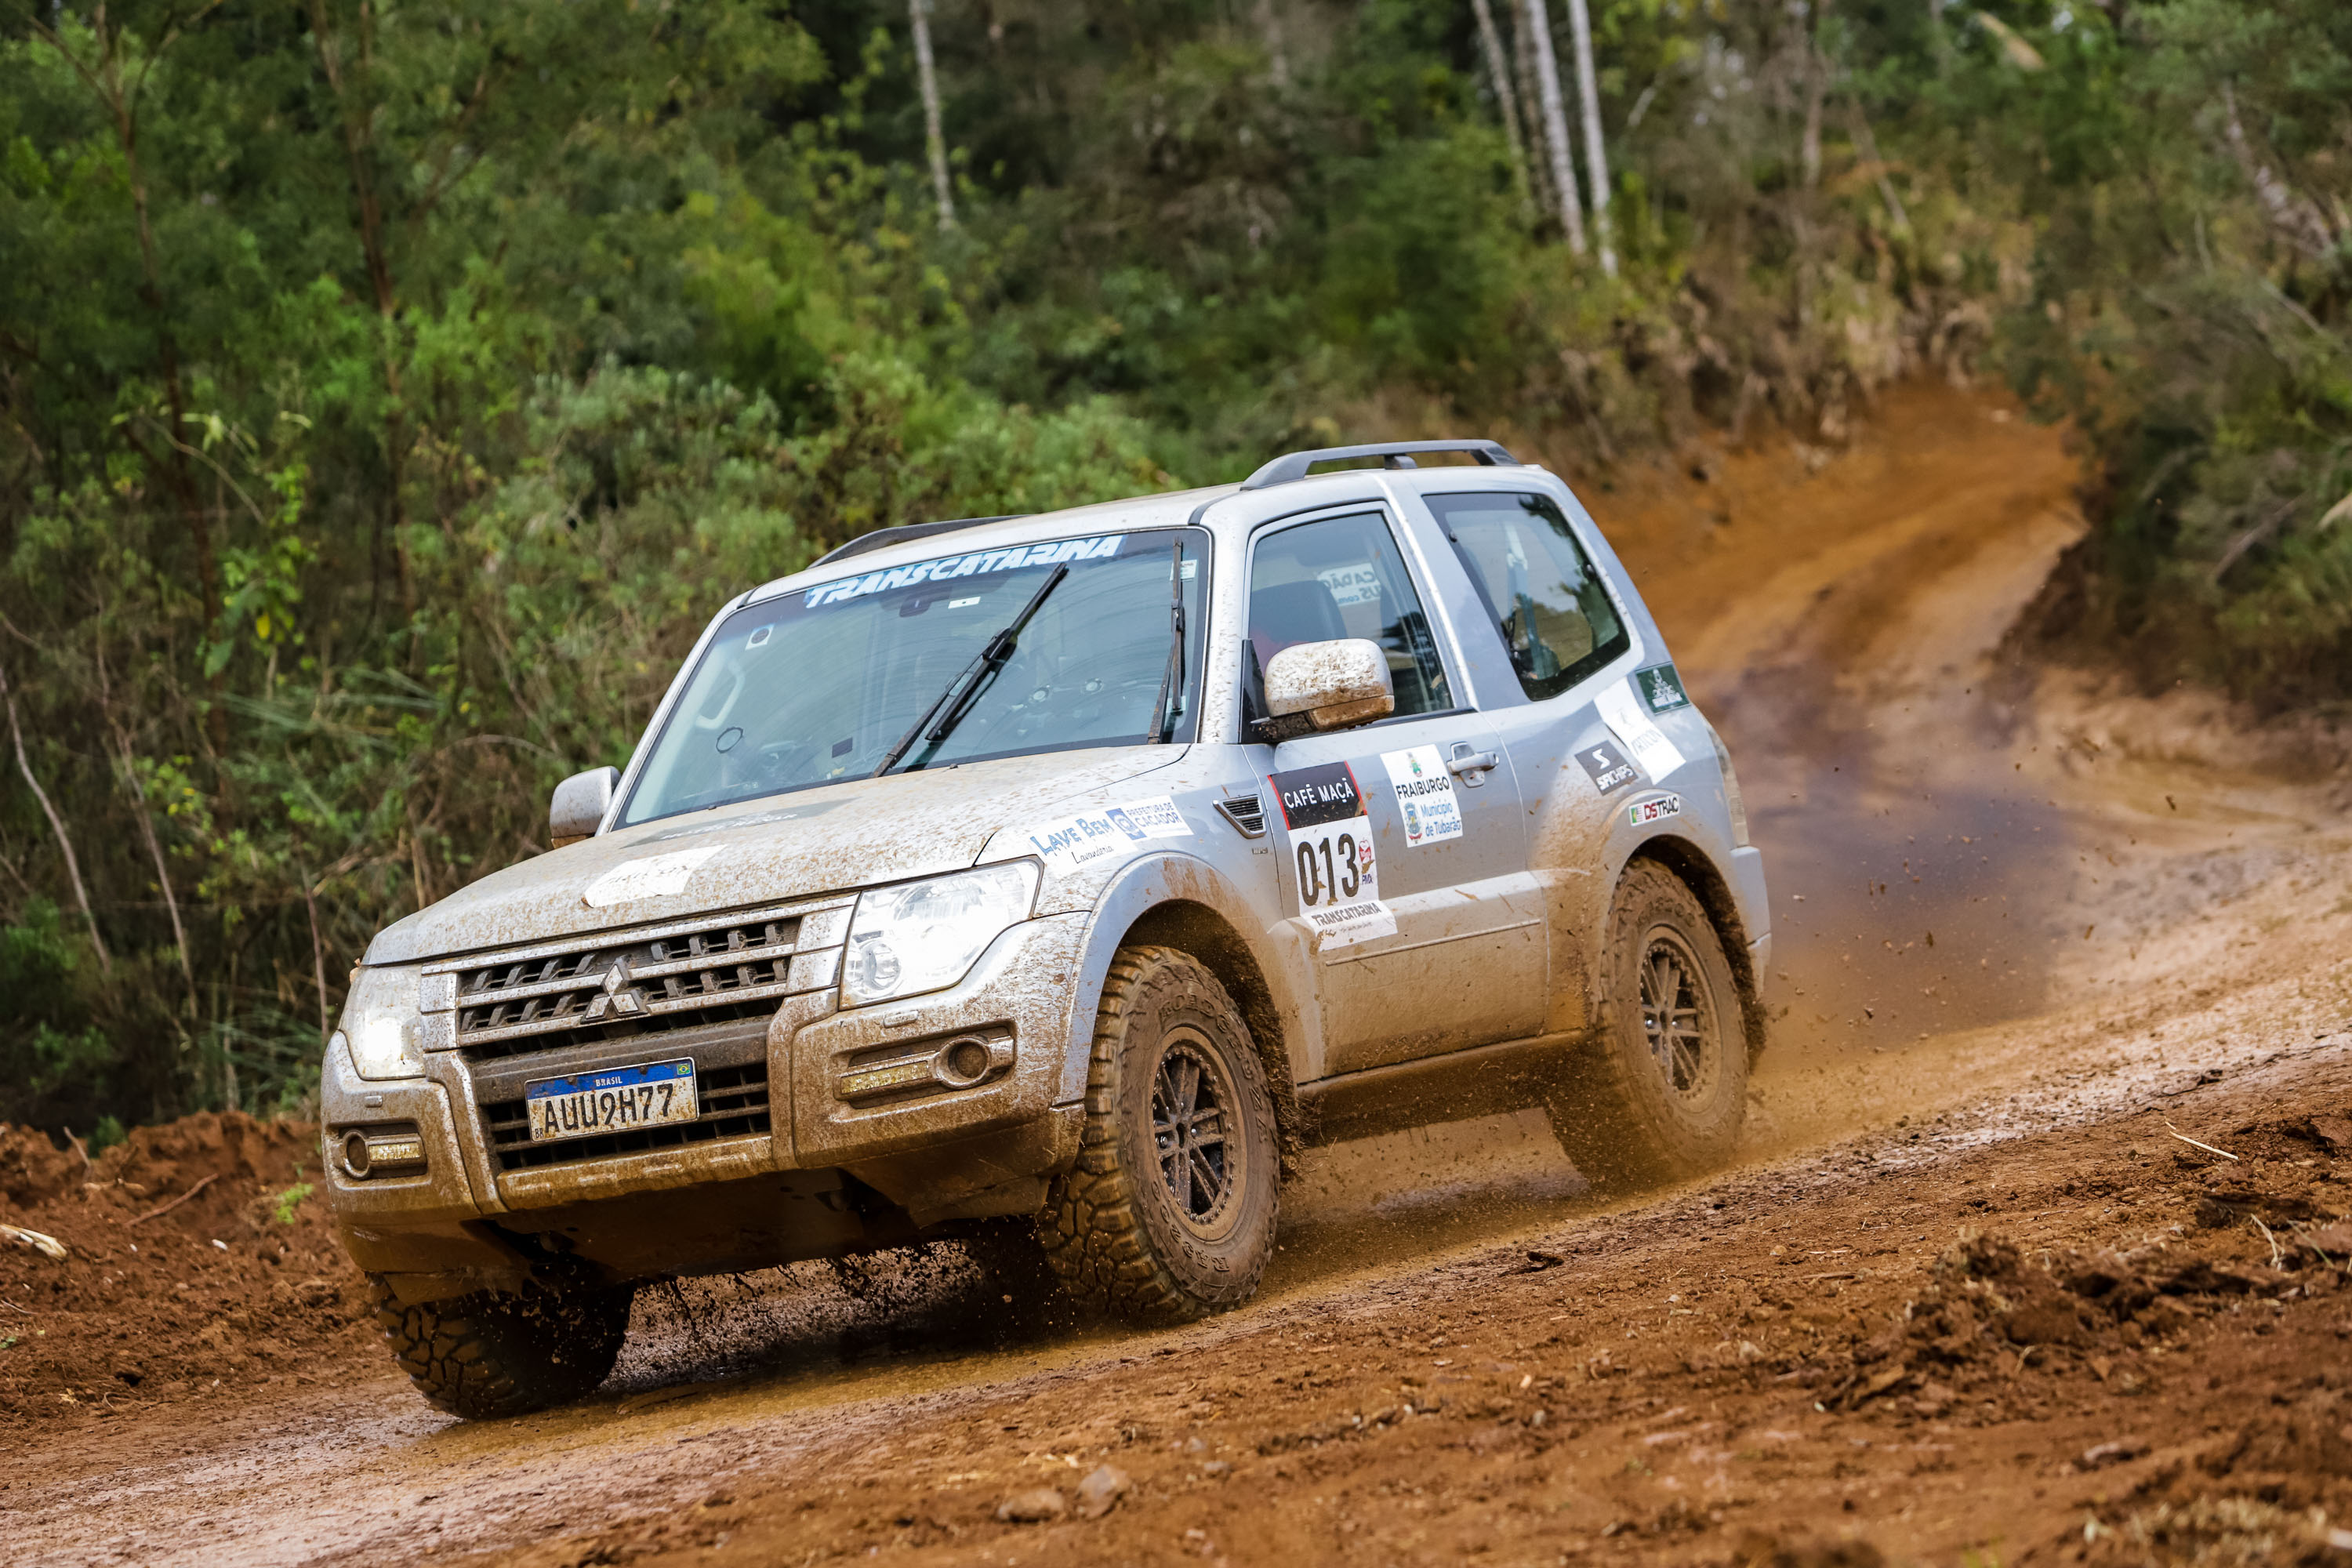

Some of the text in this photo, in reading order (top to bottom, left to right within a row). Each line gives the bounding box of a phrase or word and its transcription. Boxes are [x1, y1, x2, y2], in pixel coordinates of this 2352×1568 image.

[806, 535, 1122, 608] TRANSCATARINA
[1283, 777, 1355, 810] CAFÉ MAÇÃ
[1396, 776, 1450, 799] FRAIBURGO
[1126, 804, 1164, 816] PREFEITURA
[1643, 796, 1679, 820] DSTRAC
[1425, 817, 1461, 837] de Tubarão
[1029, 827, 1082, 856] LAVE
[1071, 845, 1115, 864] Lavanderia
[1297, 833, 1359, 906] 013
[1311, 902, 1382, 927] TRANSCATARINA
[595, 1076, 623, 1087] BRASIL
[545, 1083, 674, 1134] AUU9H77
[534, 1127, 544, 1138] BR
